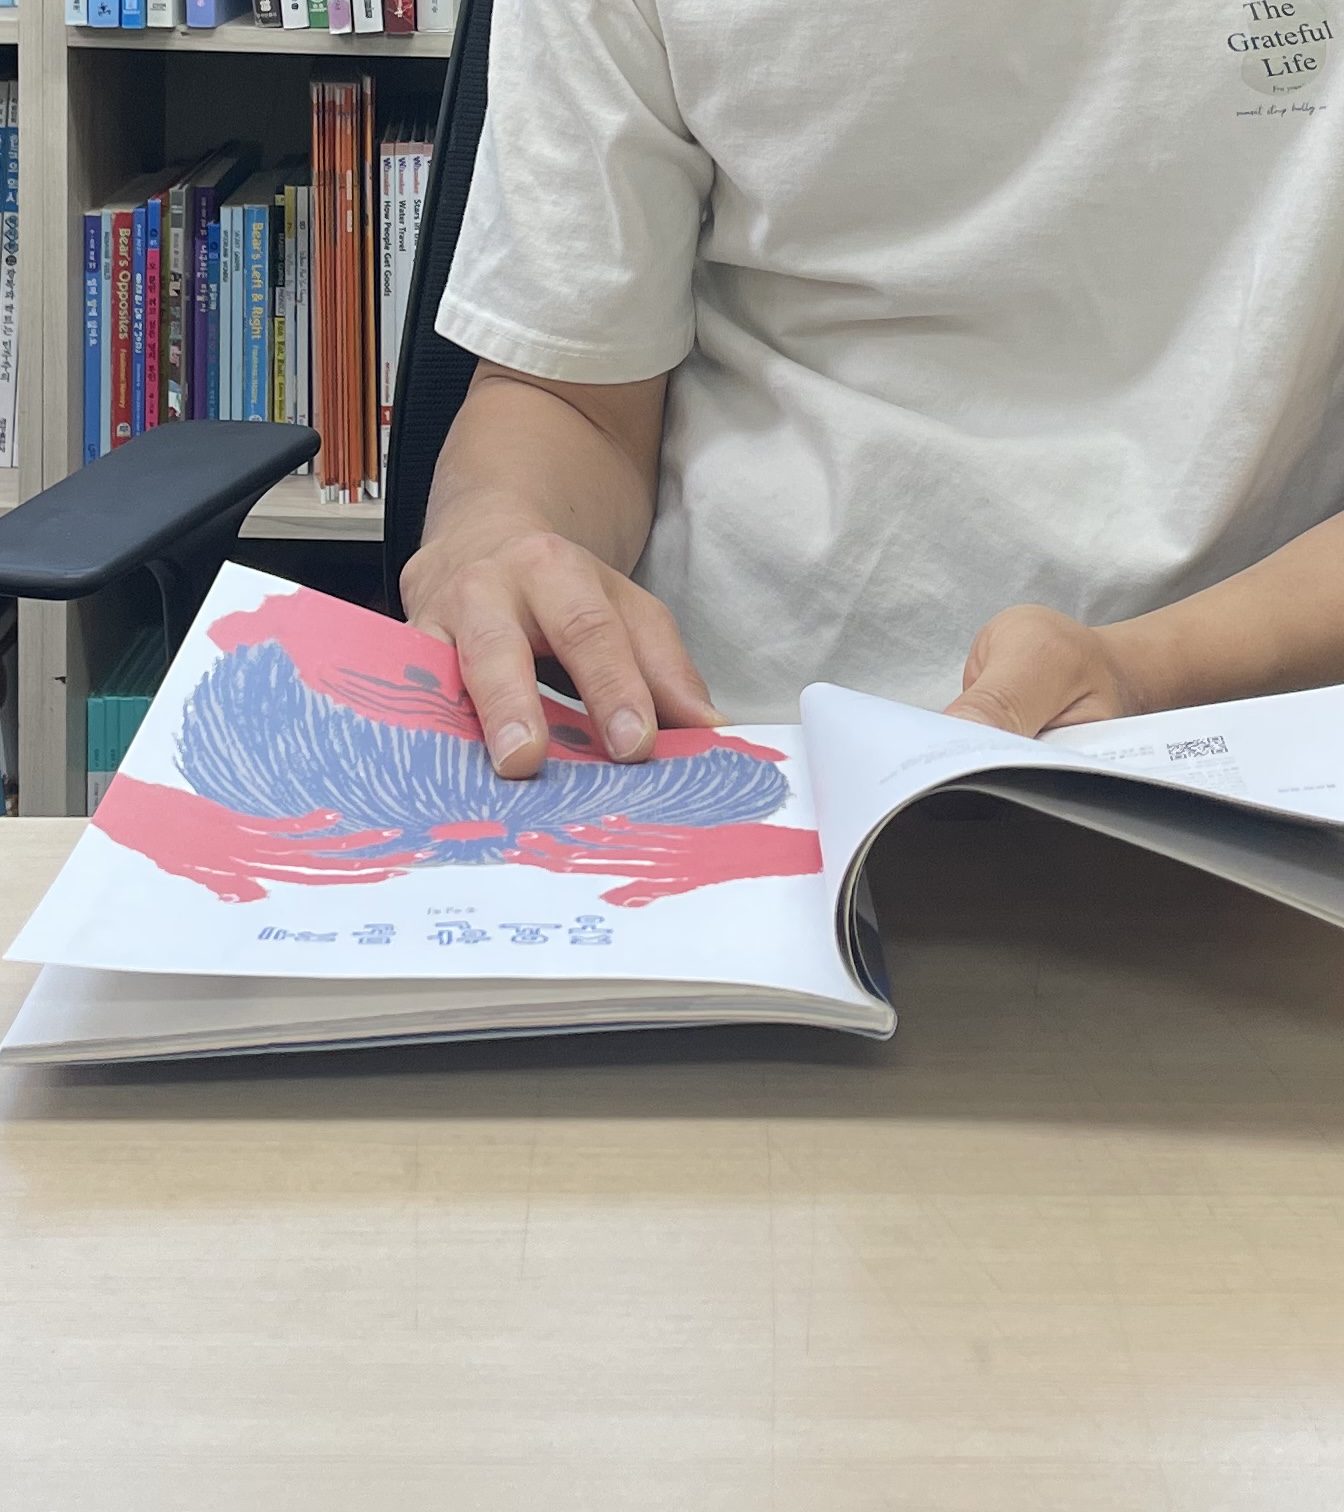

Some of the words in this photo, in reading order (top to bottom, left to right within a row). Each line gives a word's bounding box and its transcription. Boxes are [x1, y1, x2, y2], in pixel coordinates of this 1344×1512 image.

[1243, 0, 1295, 21] The
[1228, 20, 1334, 52] Grateful
[1261, 53, 1317, 77] Life
[117, 227, 131, 267] Bear's
[117, 269, 131, 340] Opposites
